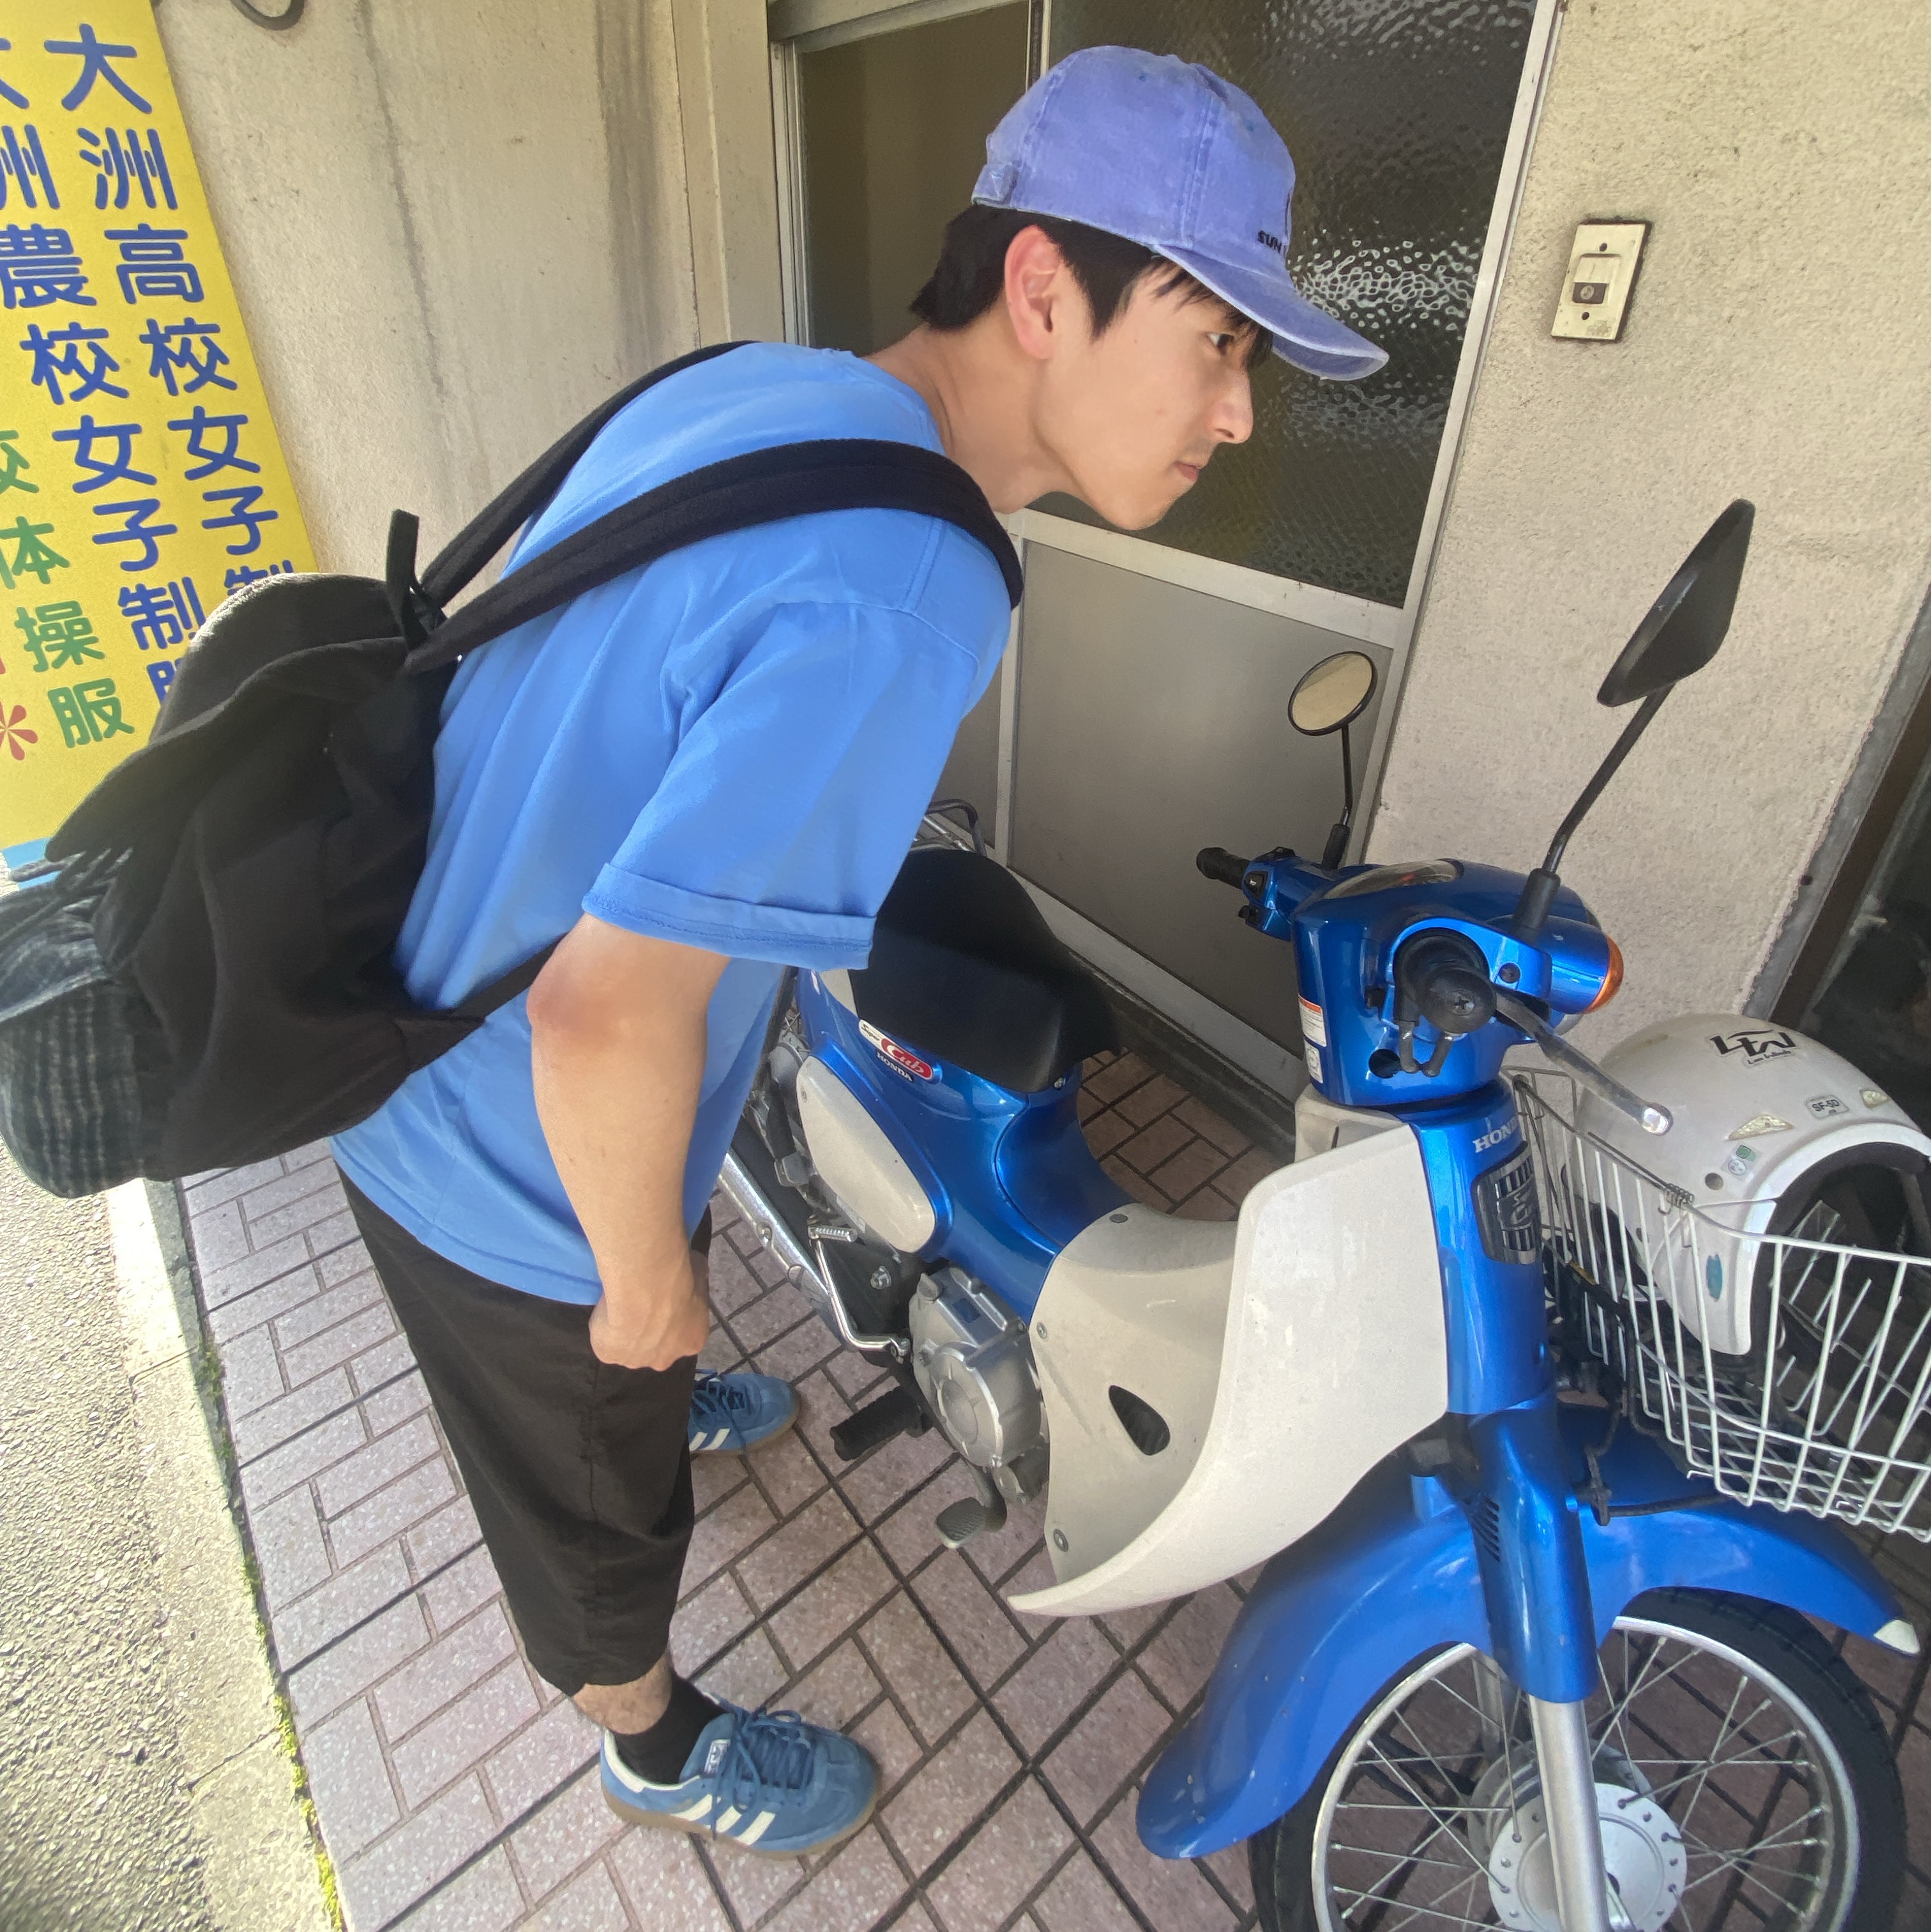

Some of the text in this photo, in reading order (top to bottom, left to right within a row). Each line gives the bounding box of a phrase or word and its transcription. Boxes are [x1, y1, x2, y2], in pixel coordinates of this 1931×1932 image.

[862, 1023, 925, 1074] Super Cub
[877, 1051, 913, 1082] HONDA
